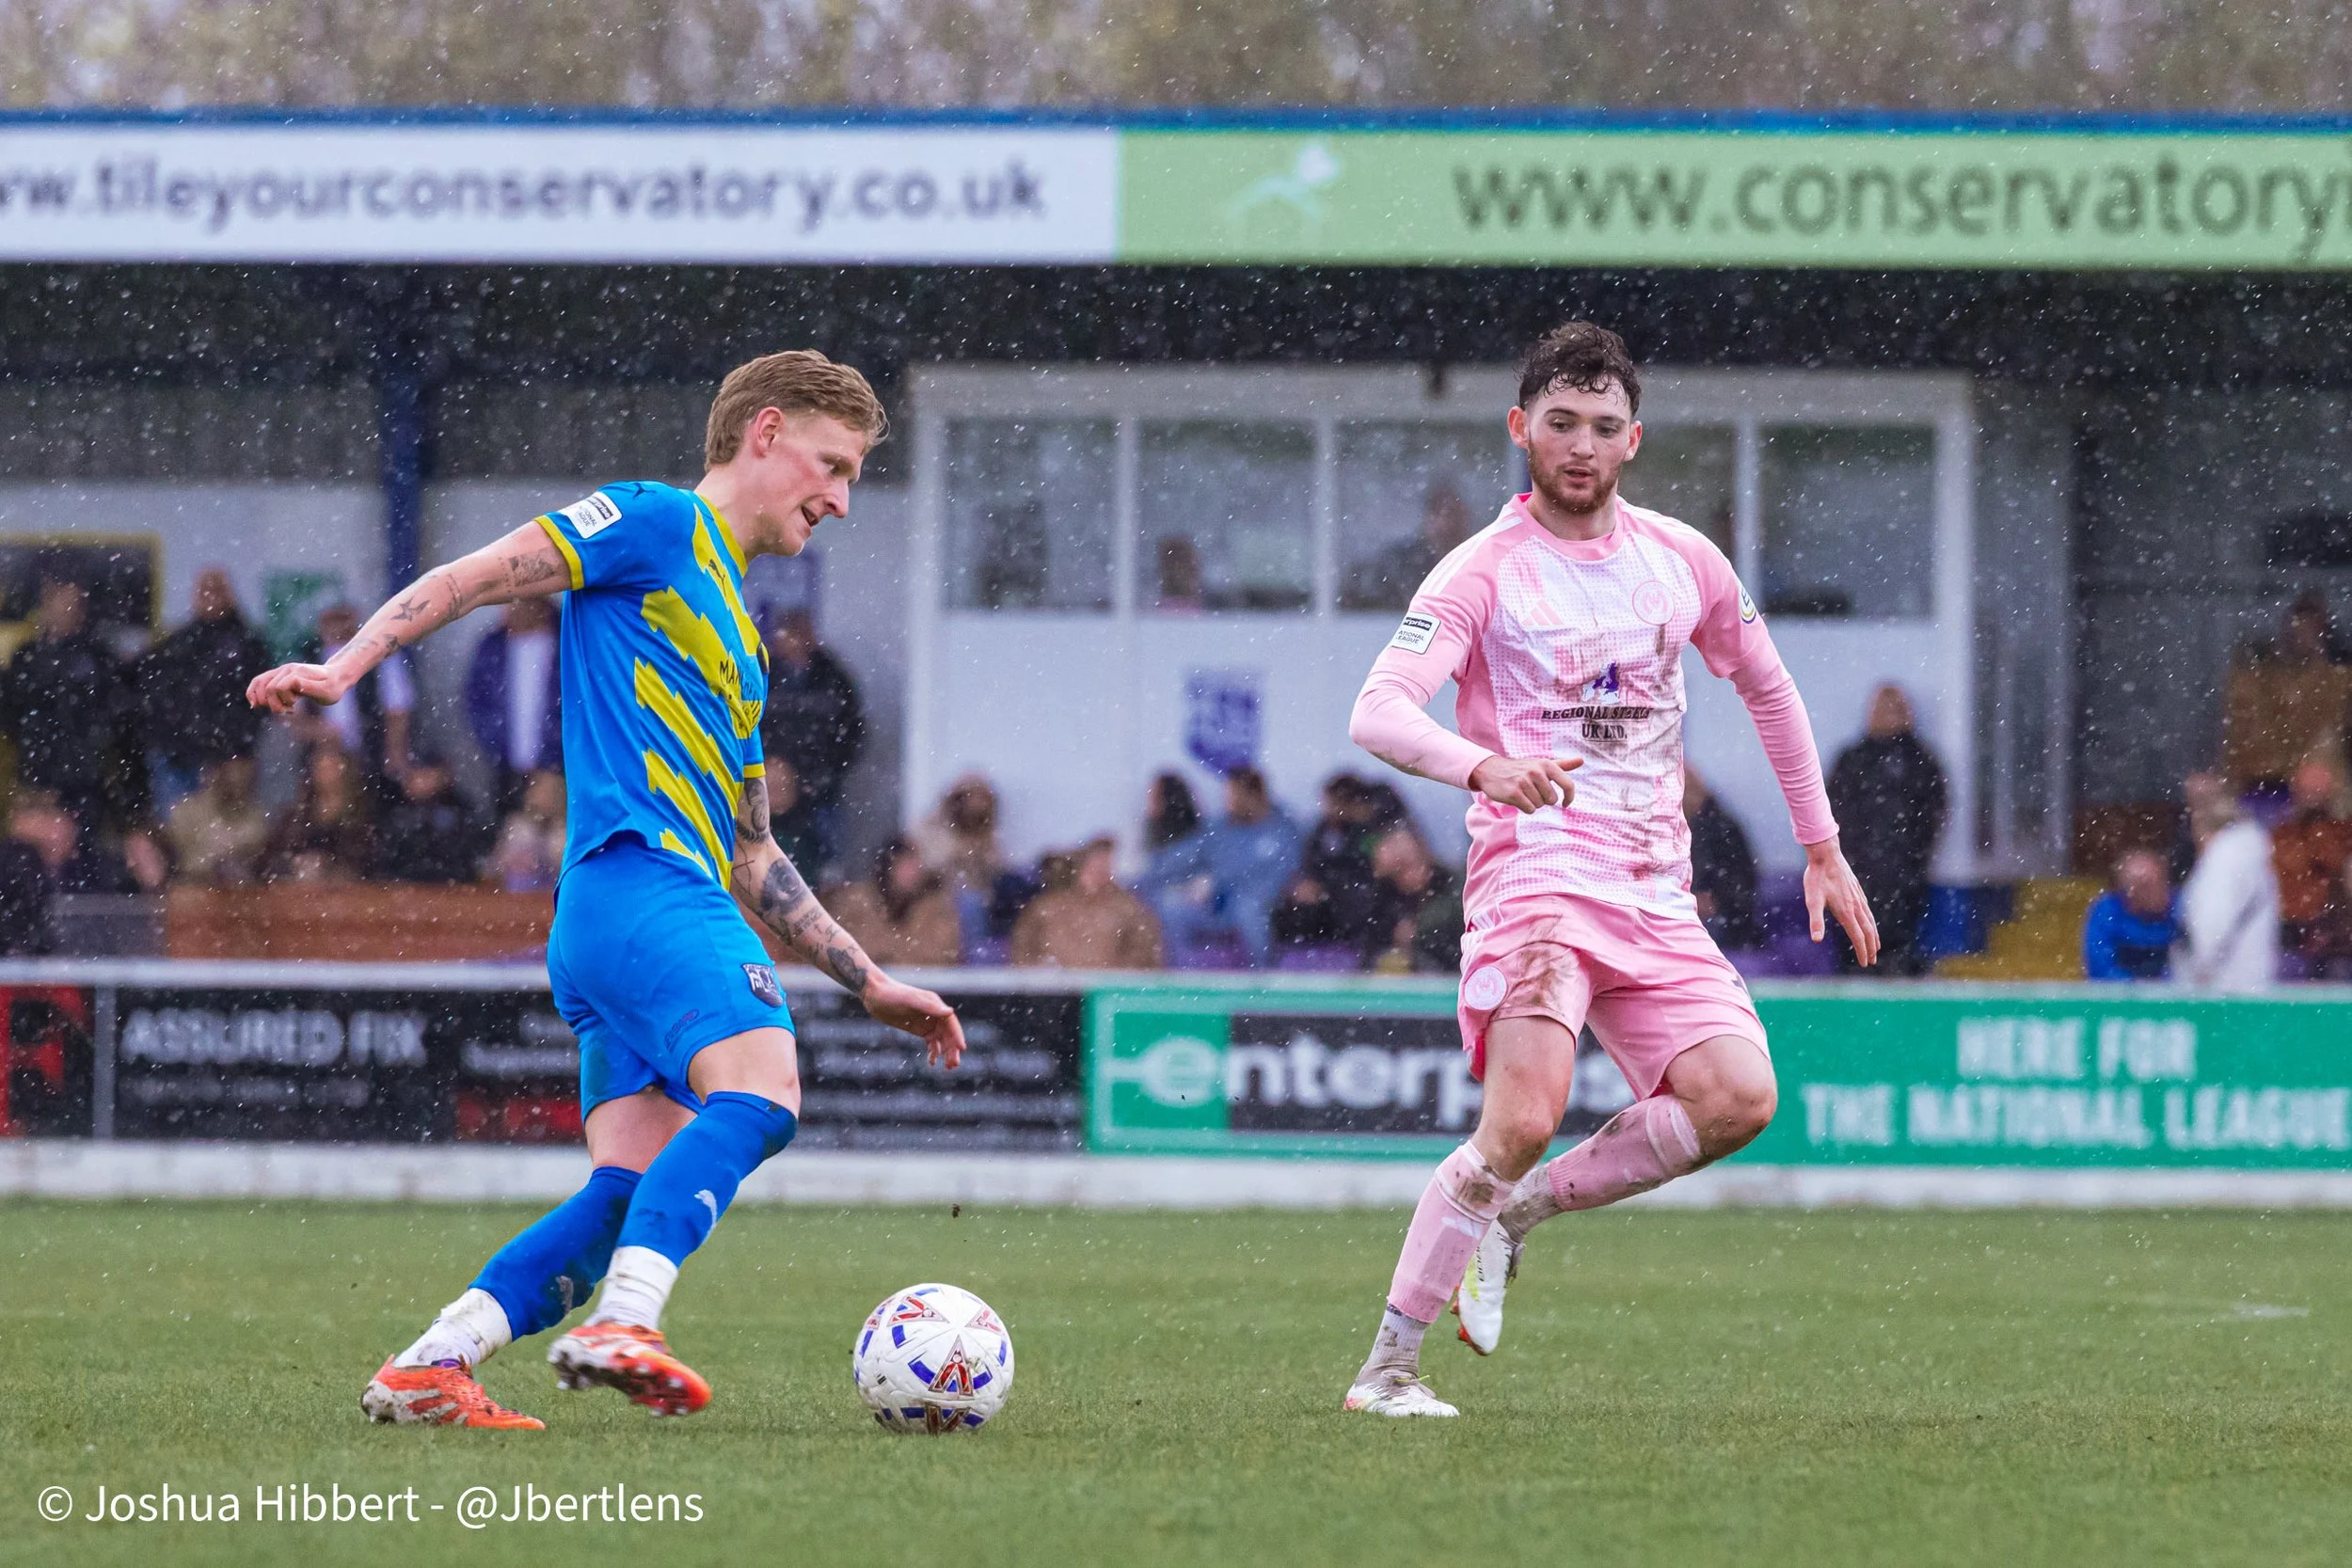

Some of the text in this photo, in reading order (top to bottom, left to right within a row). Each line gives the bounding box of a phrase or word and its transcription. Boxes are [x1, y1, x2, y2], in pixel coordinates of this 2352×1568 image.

[1452, 149, 2352, 265] www.conservatory
[1396, 635, 1421, 644] EAGUE
[1398, 630, 1425, 641] ATIONAL
[1541, 705, 1609, 721] REGIONAL
[1581, 723, 1628, 739] UK LTD.
[2097, 1017, 2197, 1081] FOR
[1801, 1082, 2352, 1150] THE NATIONAL LEAGUE
